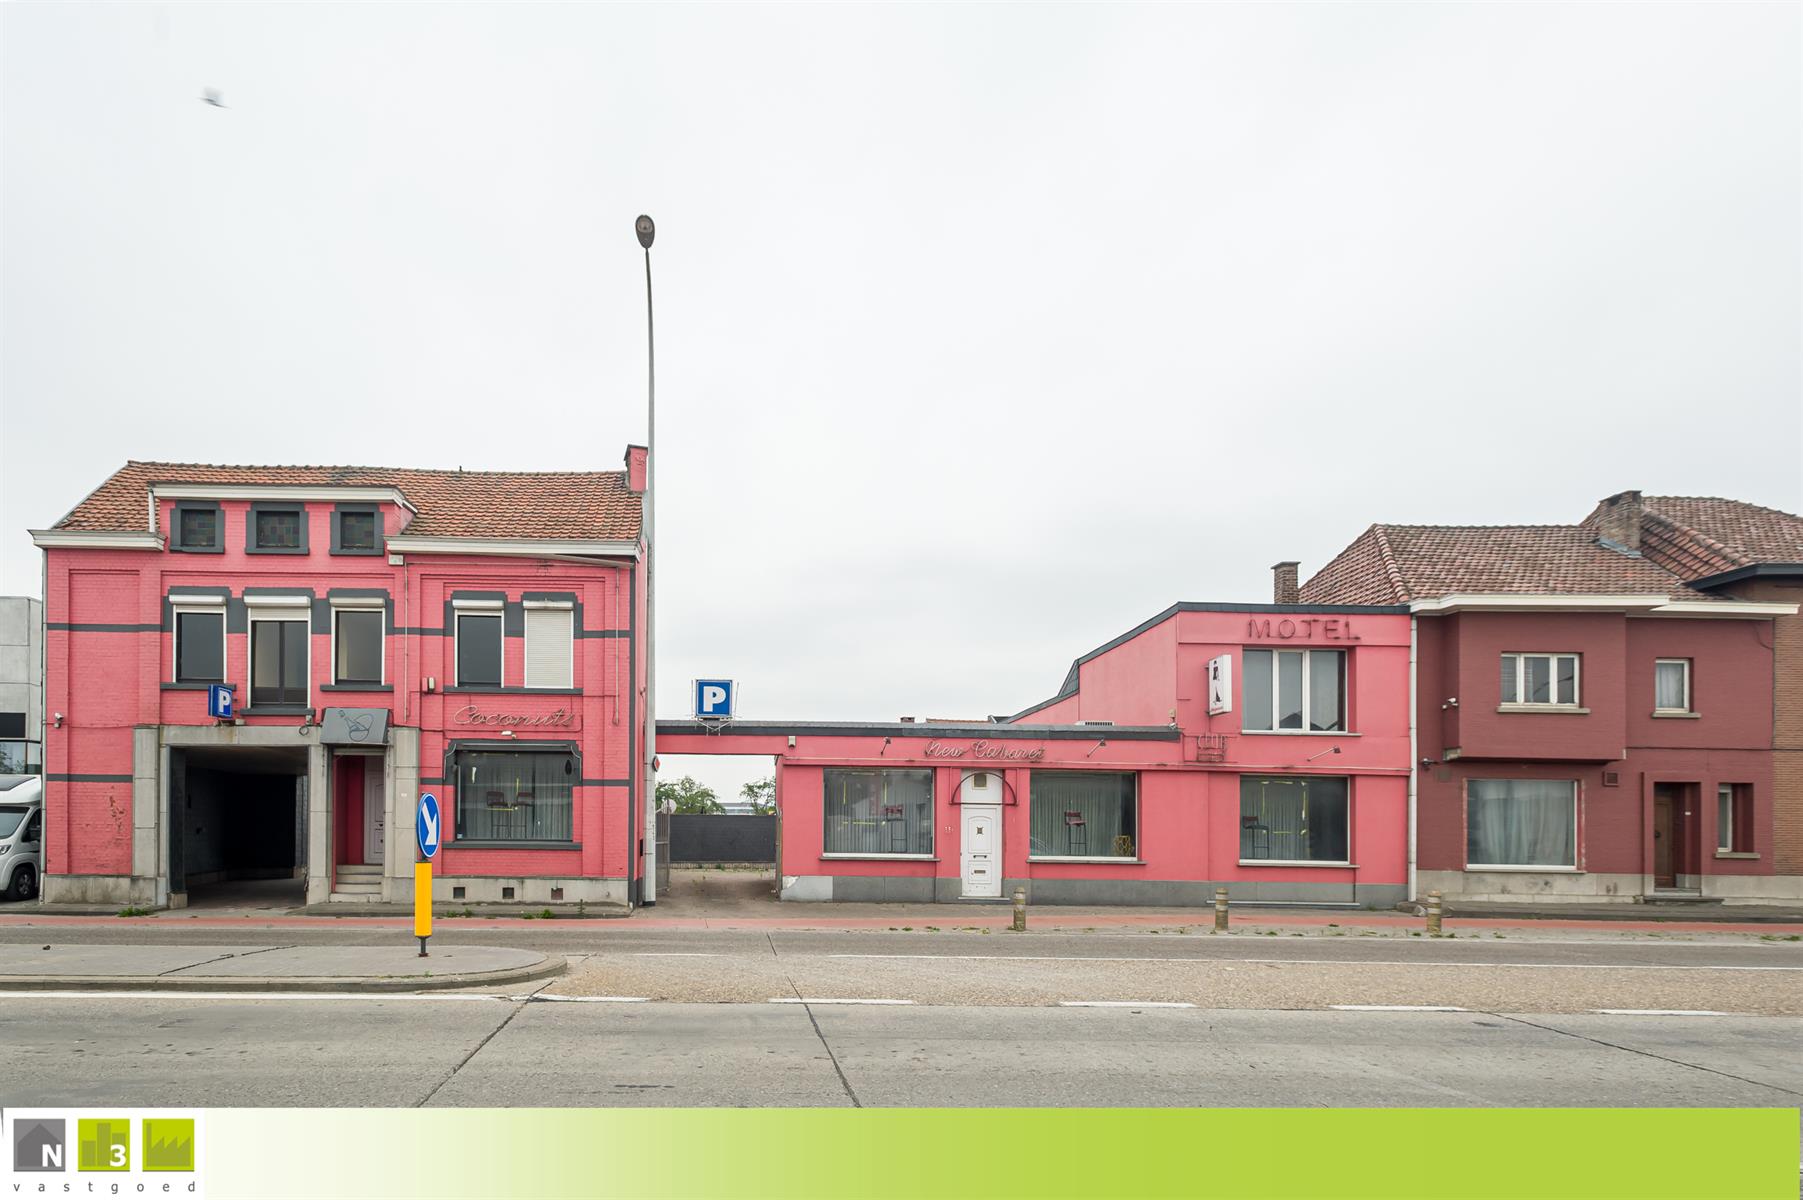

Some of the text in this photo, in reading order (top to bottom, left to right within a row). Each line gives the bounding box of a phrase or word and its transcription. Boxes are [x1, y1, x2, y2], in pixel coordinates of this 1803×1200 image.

[1247, 618, 1361, 640] MOTEL
[219, 690, 232, 713] P
[704, 686, 727, 712] P
[925, 739, 1046, 760] New Cabaret
